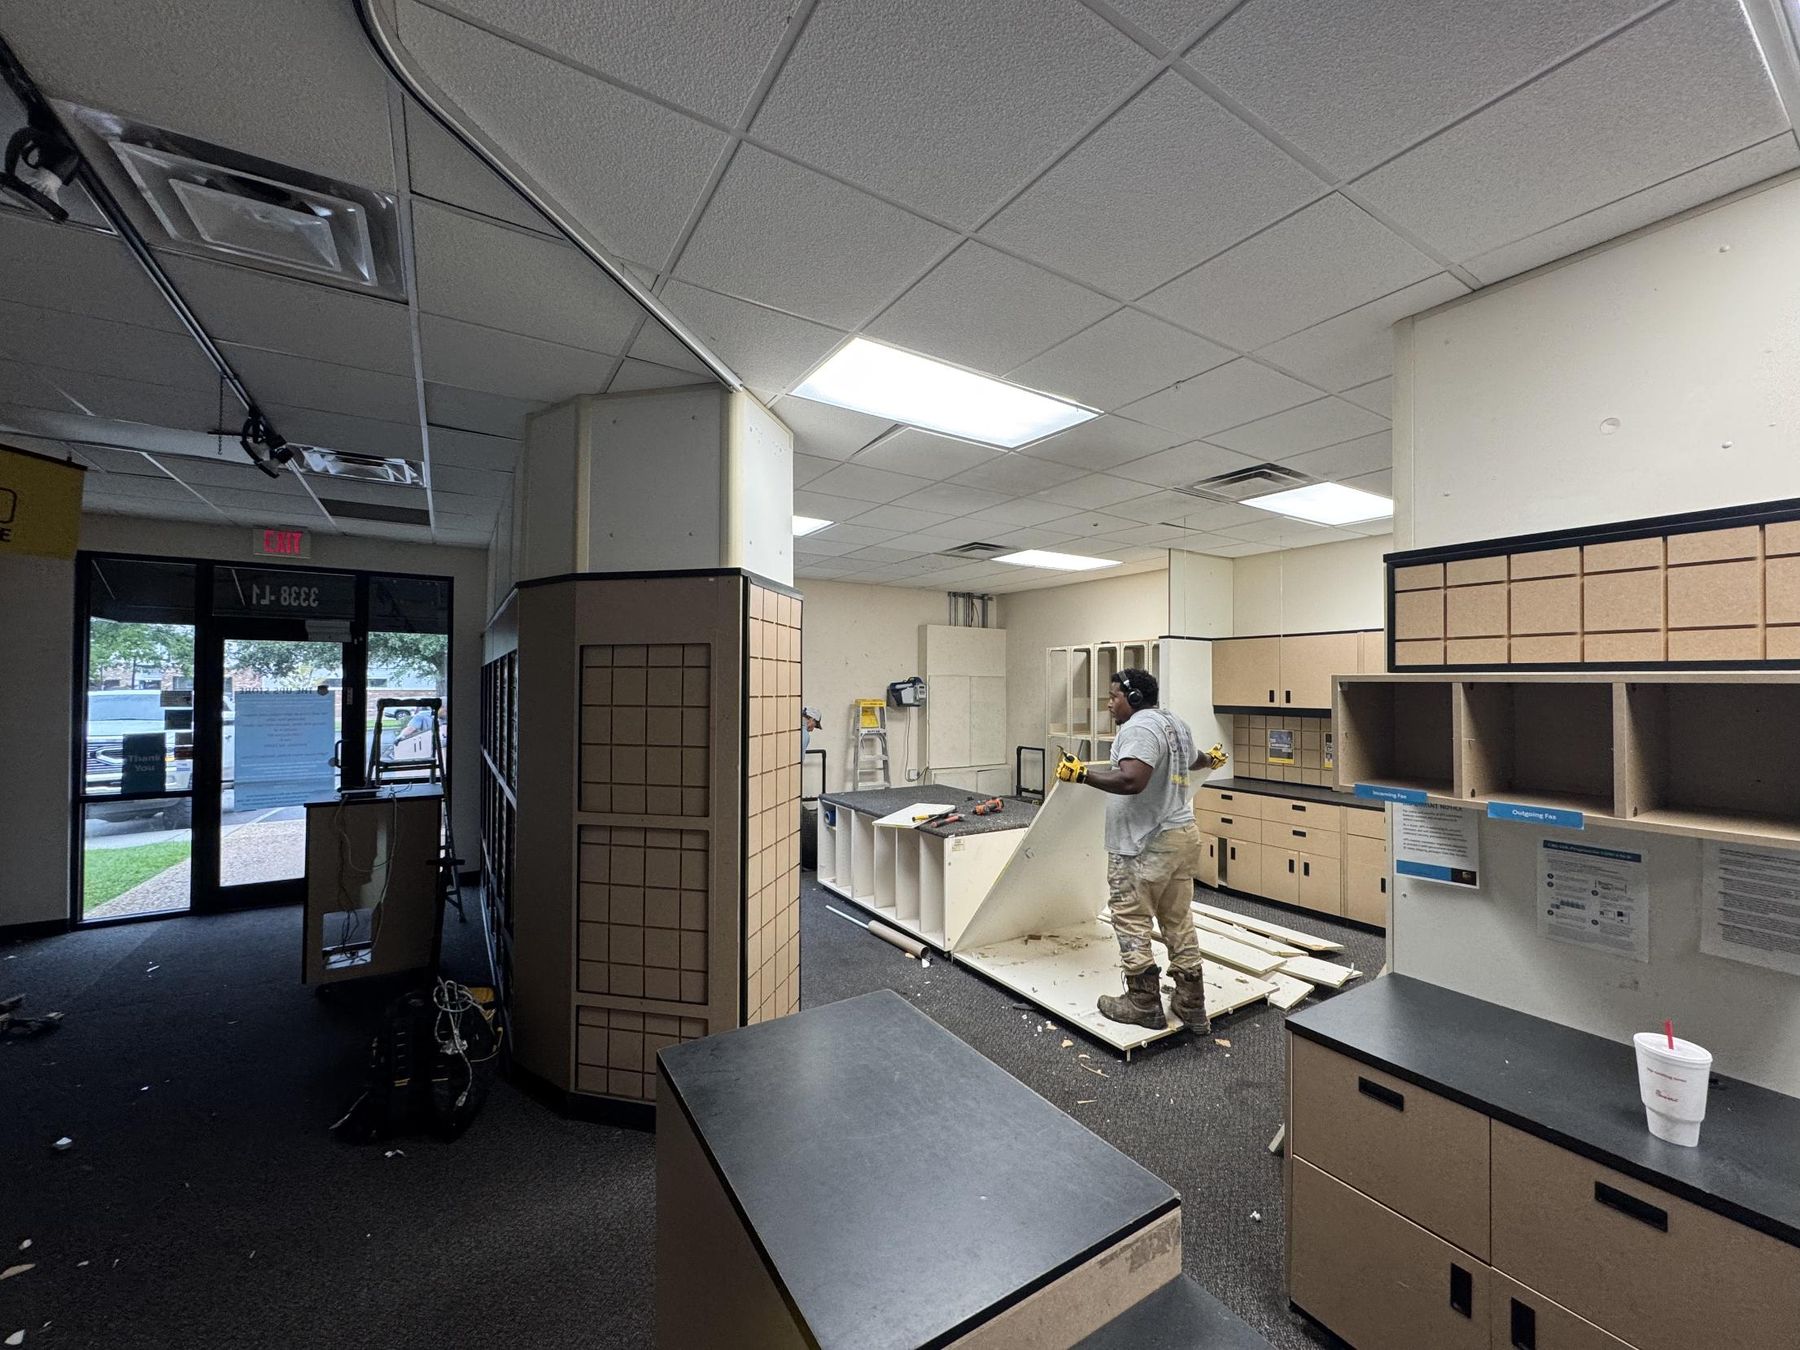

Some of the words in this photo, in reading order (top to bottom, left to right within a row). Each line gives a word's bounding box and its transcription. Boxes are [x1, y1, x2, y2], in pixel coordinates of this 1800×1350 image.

[263, 529, 303, 554] EXIT
[127, 754, 161, 762] Thank
[1512, 809, 1544, 819] Outgoing
